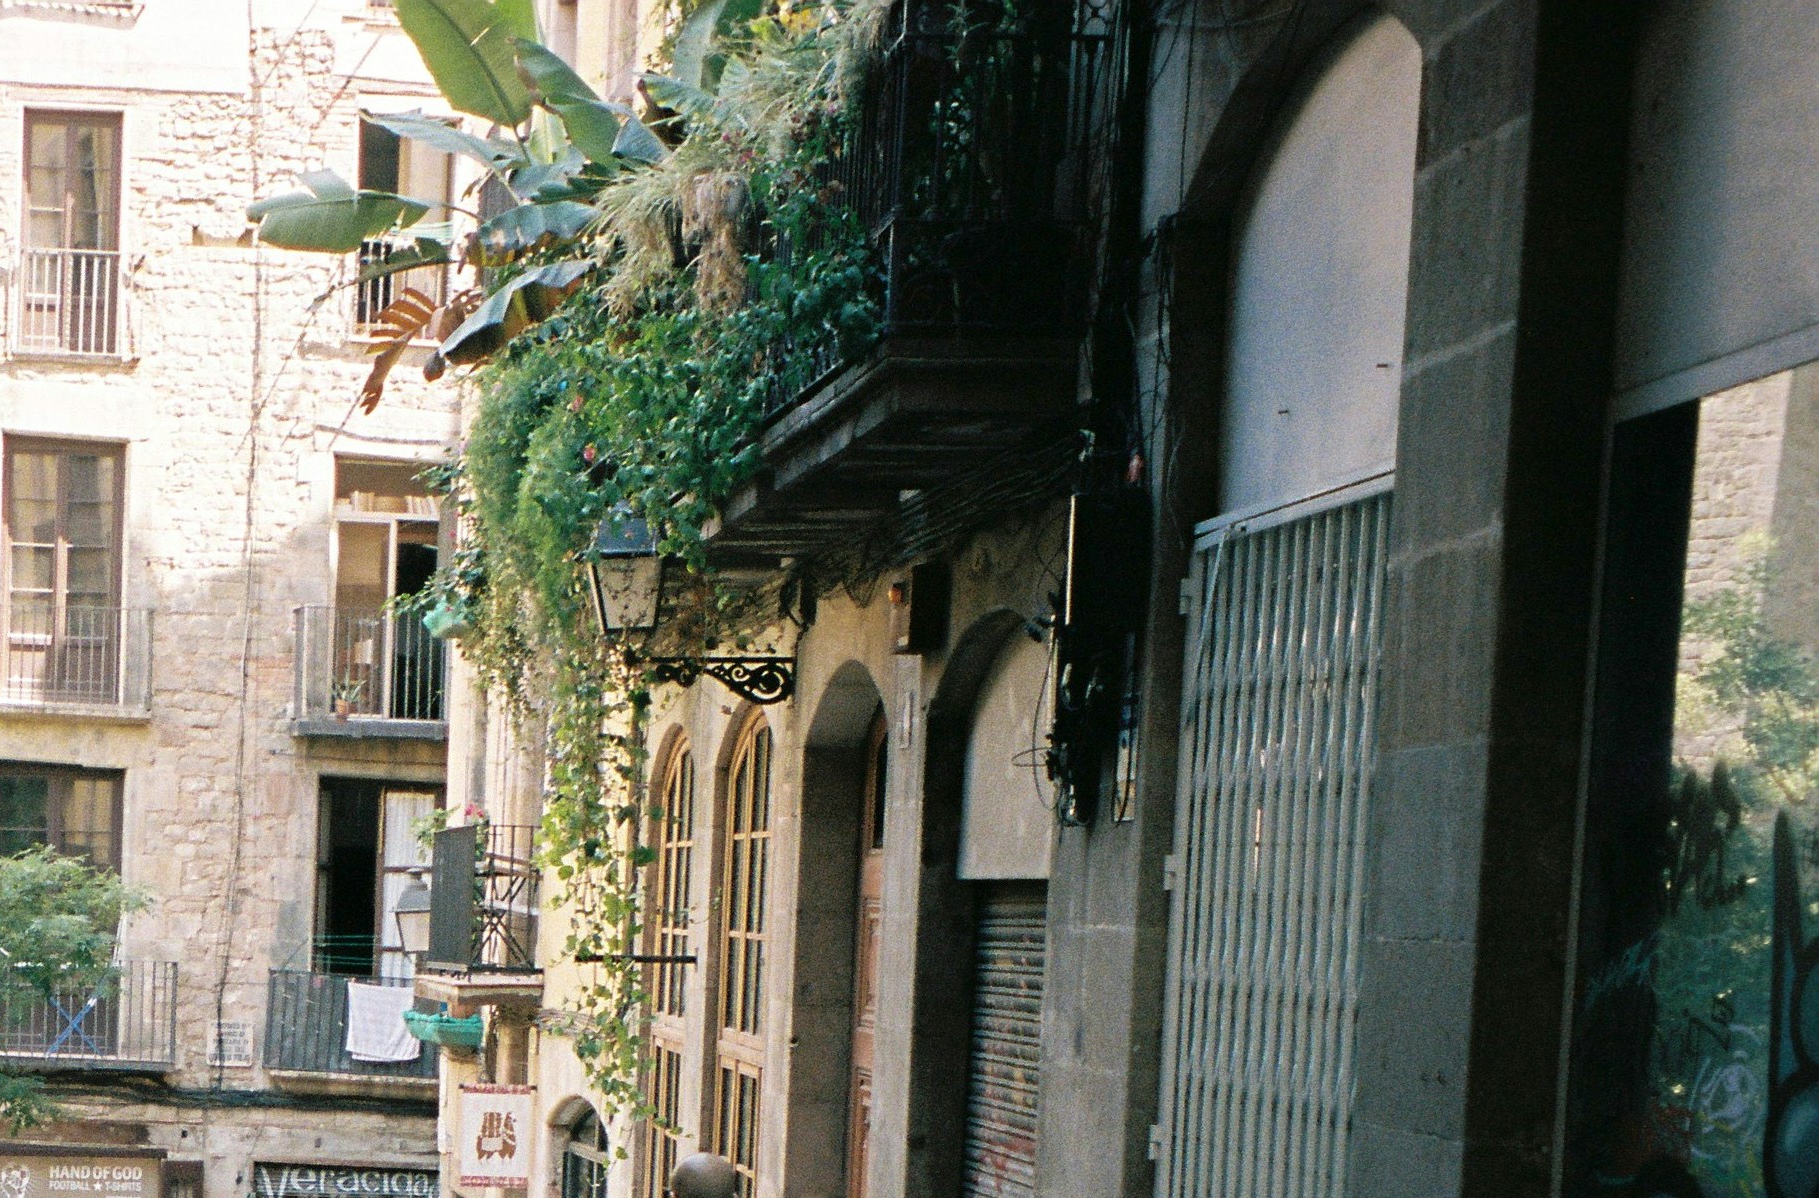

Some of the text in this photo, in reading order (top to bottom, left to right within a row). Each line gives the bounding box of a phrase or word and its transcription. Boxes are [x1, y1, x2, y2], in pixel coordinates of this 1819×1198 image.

[49, 1165, 143, 1180] HAND OF GOD
[49, 1180, 143, 1192] FOOTBALL T-SHIRTS
